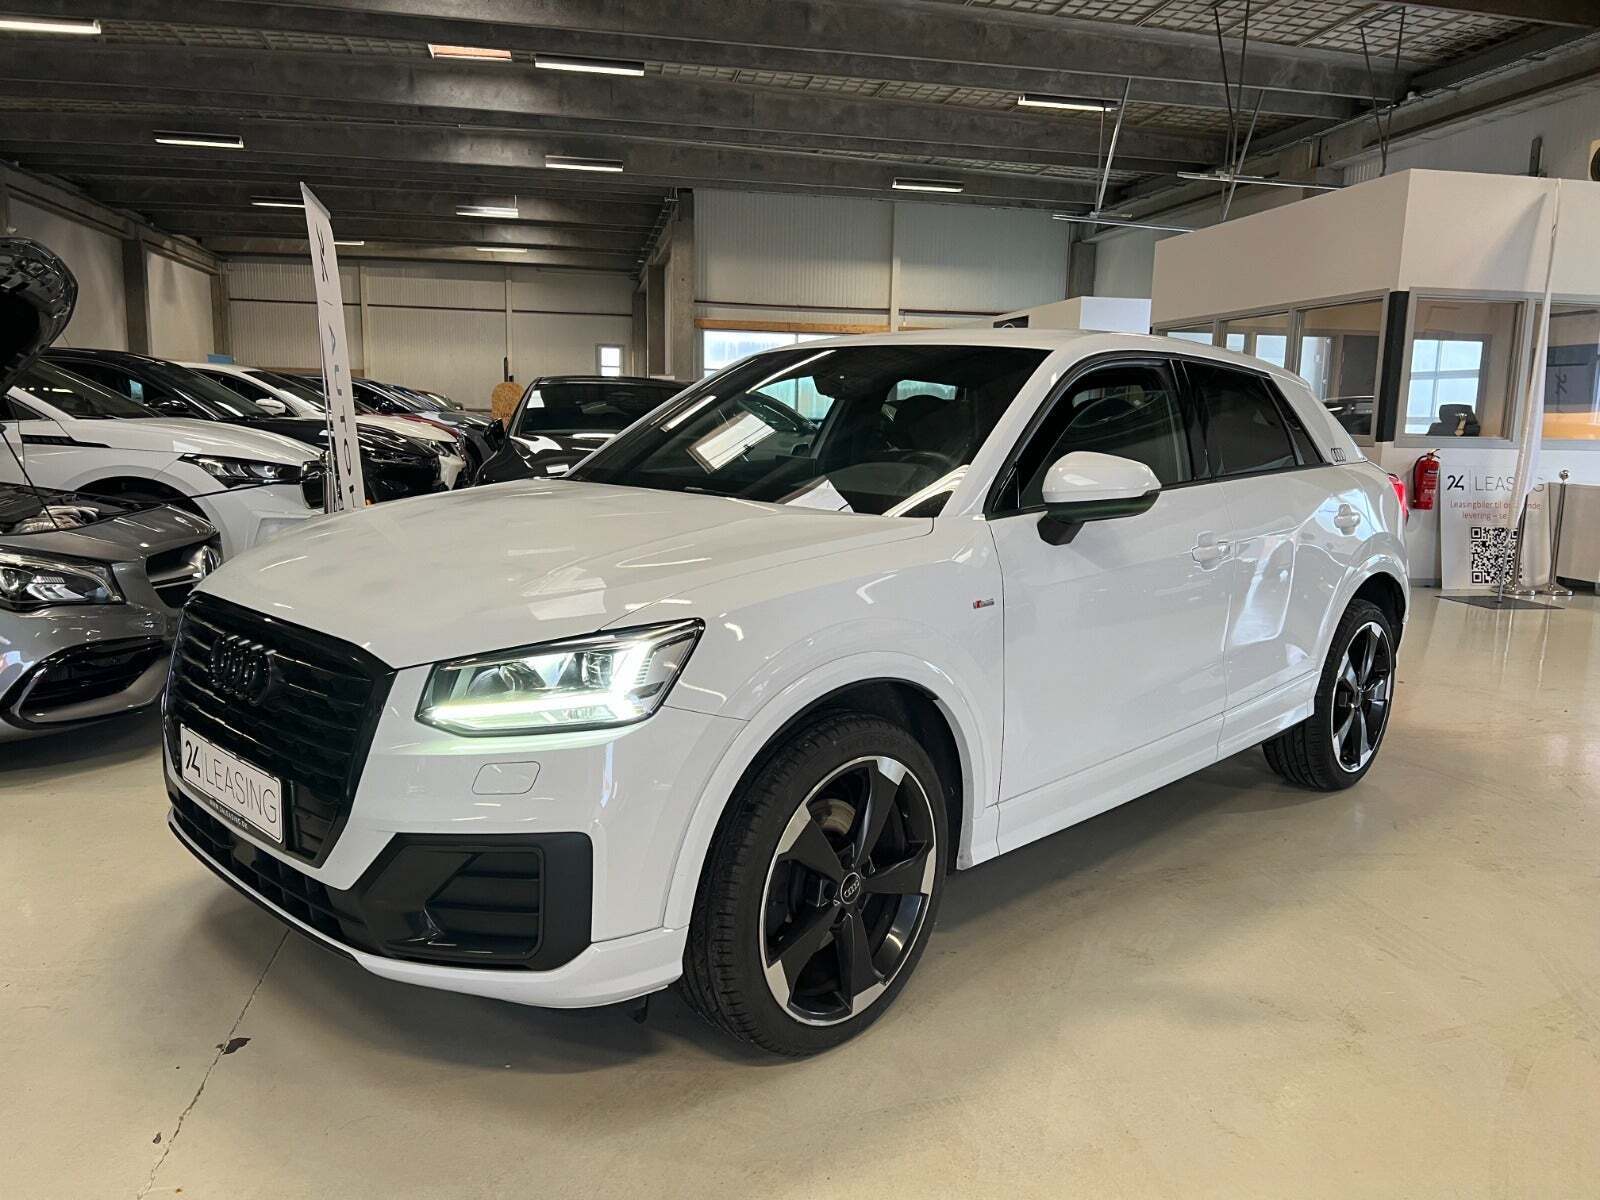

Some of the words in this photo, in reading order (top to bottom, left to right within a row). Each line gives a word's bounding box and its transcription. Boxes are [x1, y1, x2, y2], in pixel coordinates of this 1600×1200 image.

[1447, 474, 1465, 491] 24
[1475, 476, 1545, 492] LEASG
[185, 739, 201, 778] 24
[205, 751, 277, 824] LEASING
